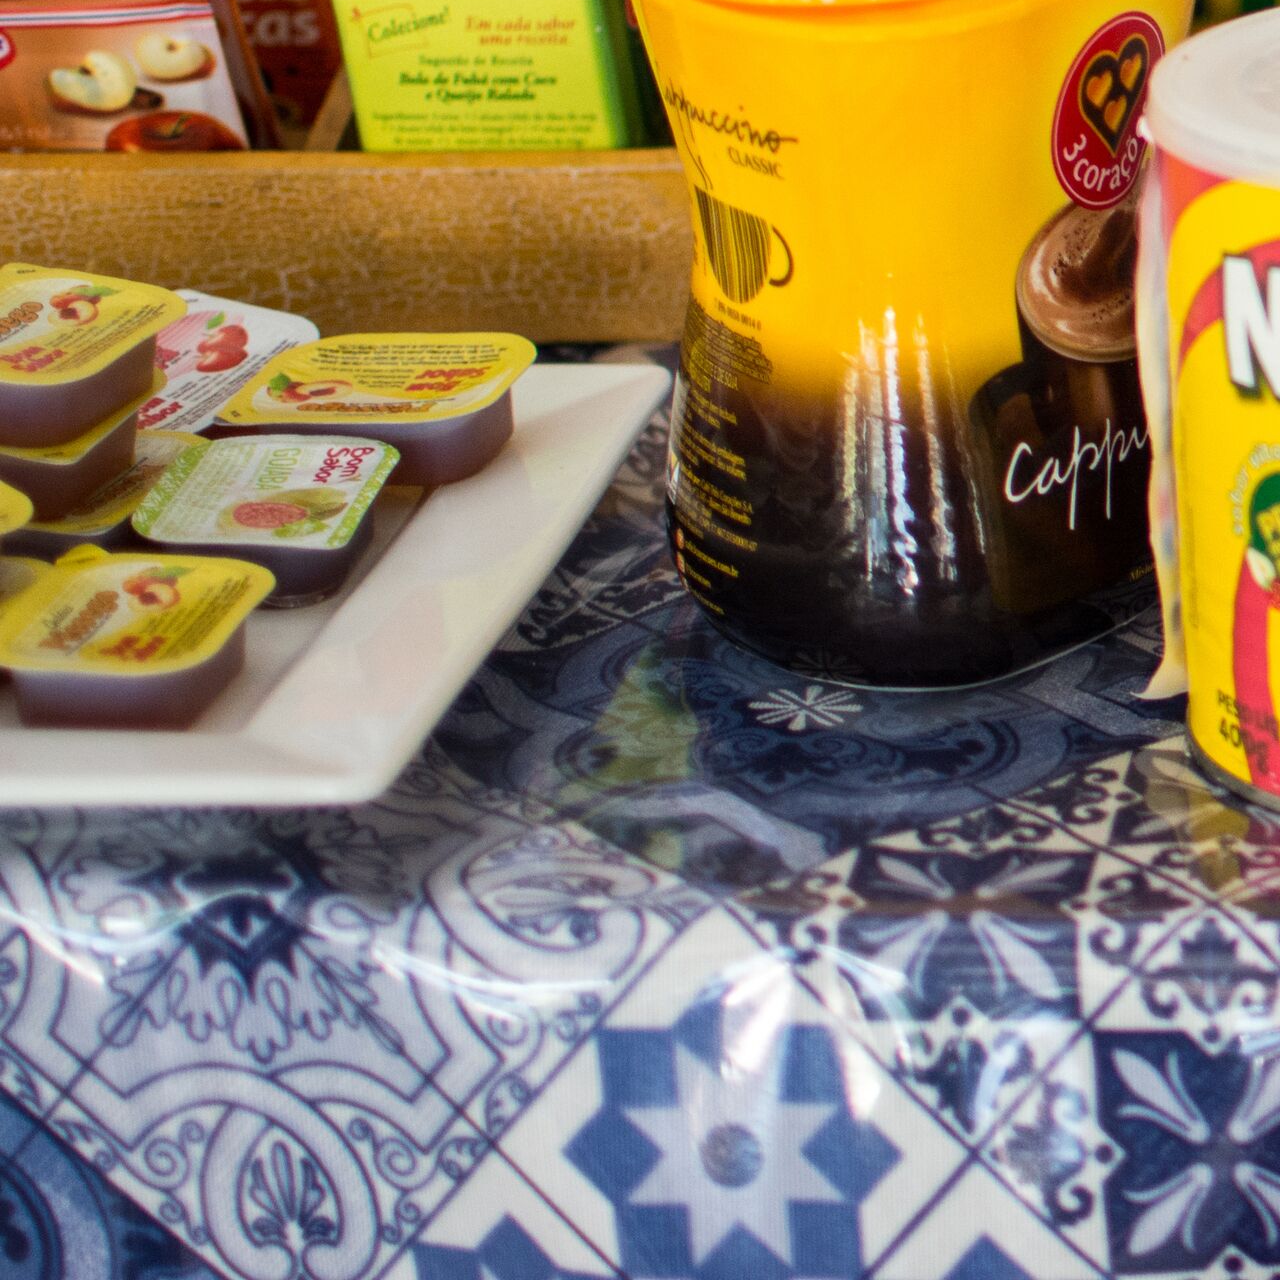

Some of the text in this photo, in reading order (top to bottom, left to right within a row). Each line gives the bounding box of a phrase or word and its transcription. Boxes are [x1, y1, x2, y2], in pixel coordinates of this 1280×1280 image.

[727, 145, 786, 181] CLASSIC
[1063, 133, 1088, 162] 3
[255, 448, 302, 492] GOIABA
[312, 447, 350, 486] Sabor
[339, 446, 376, 484] Bom
